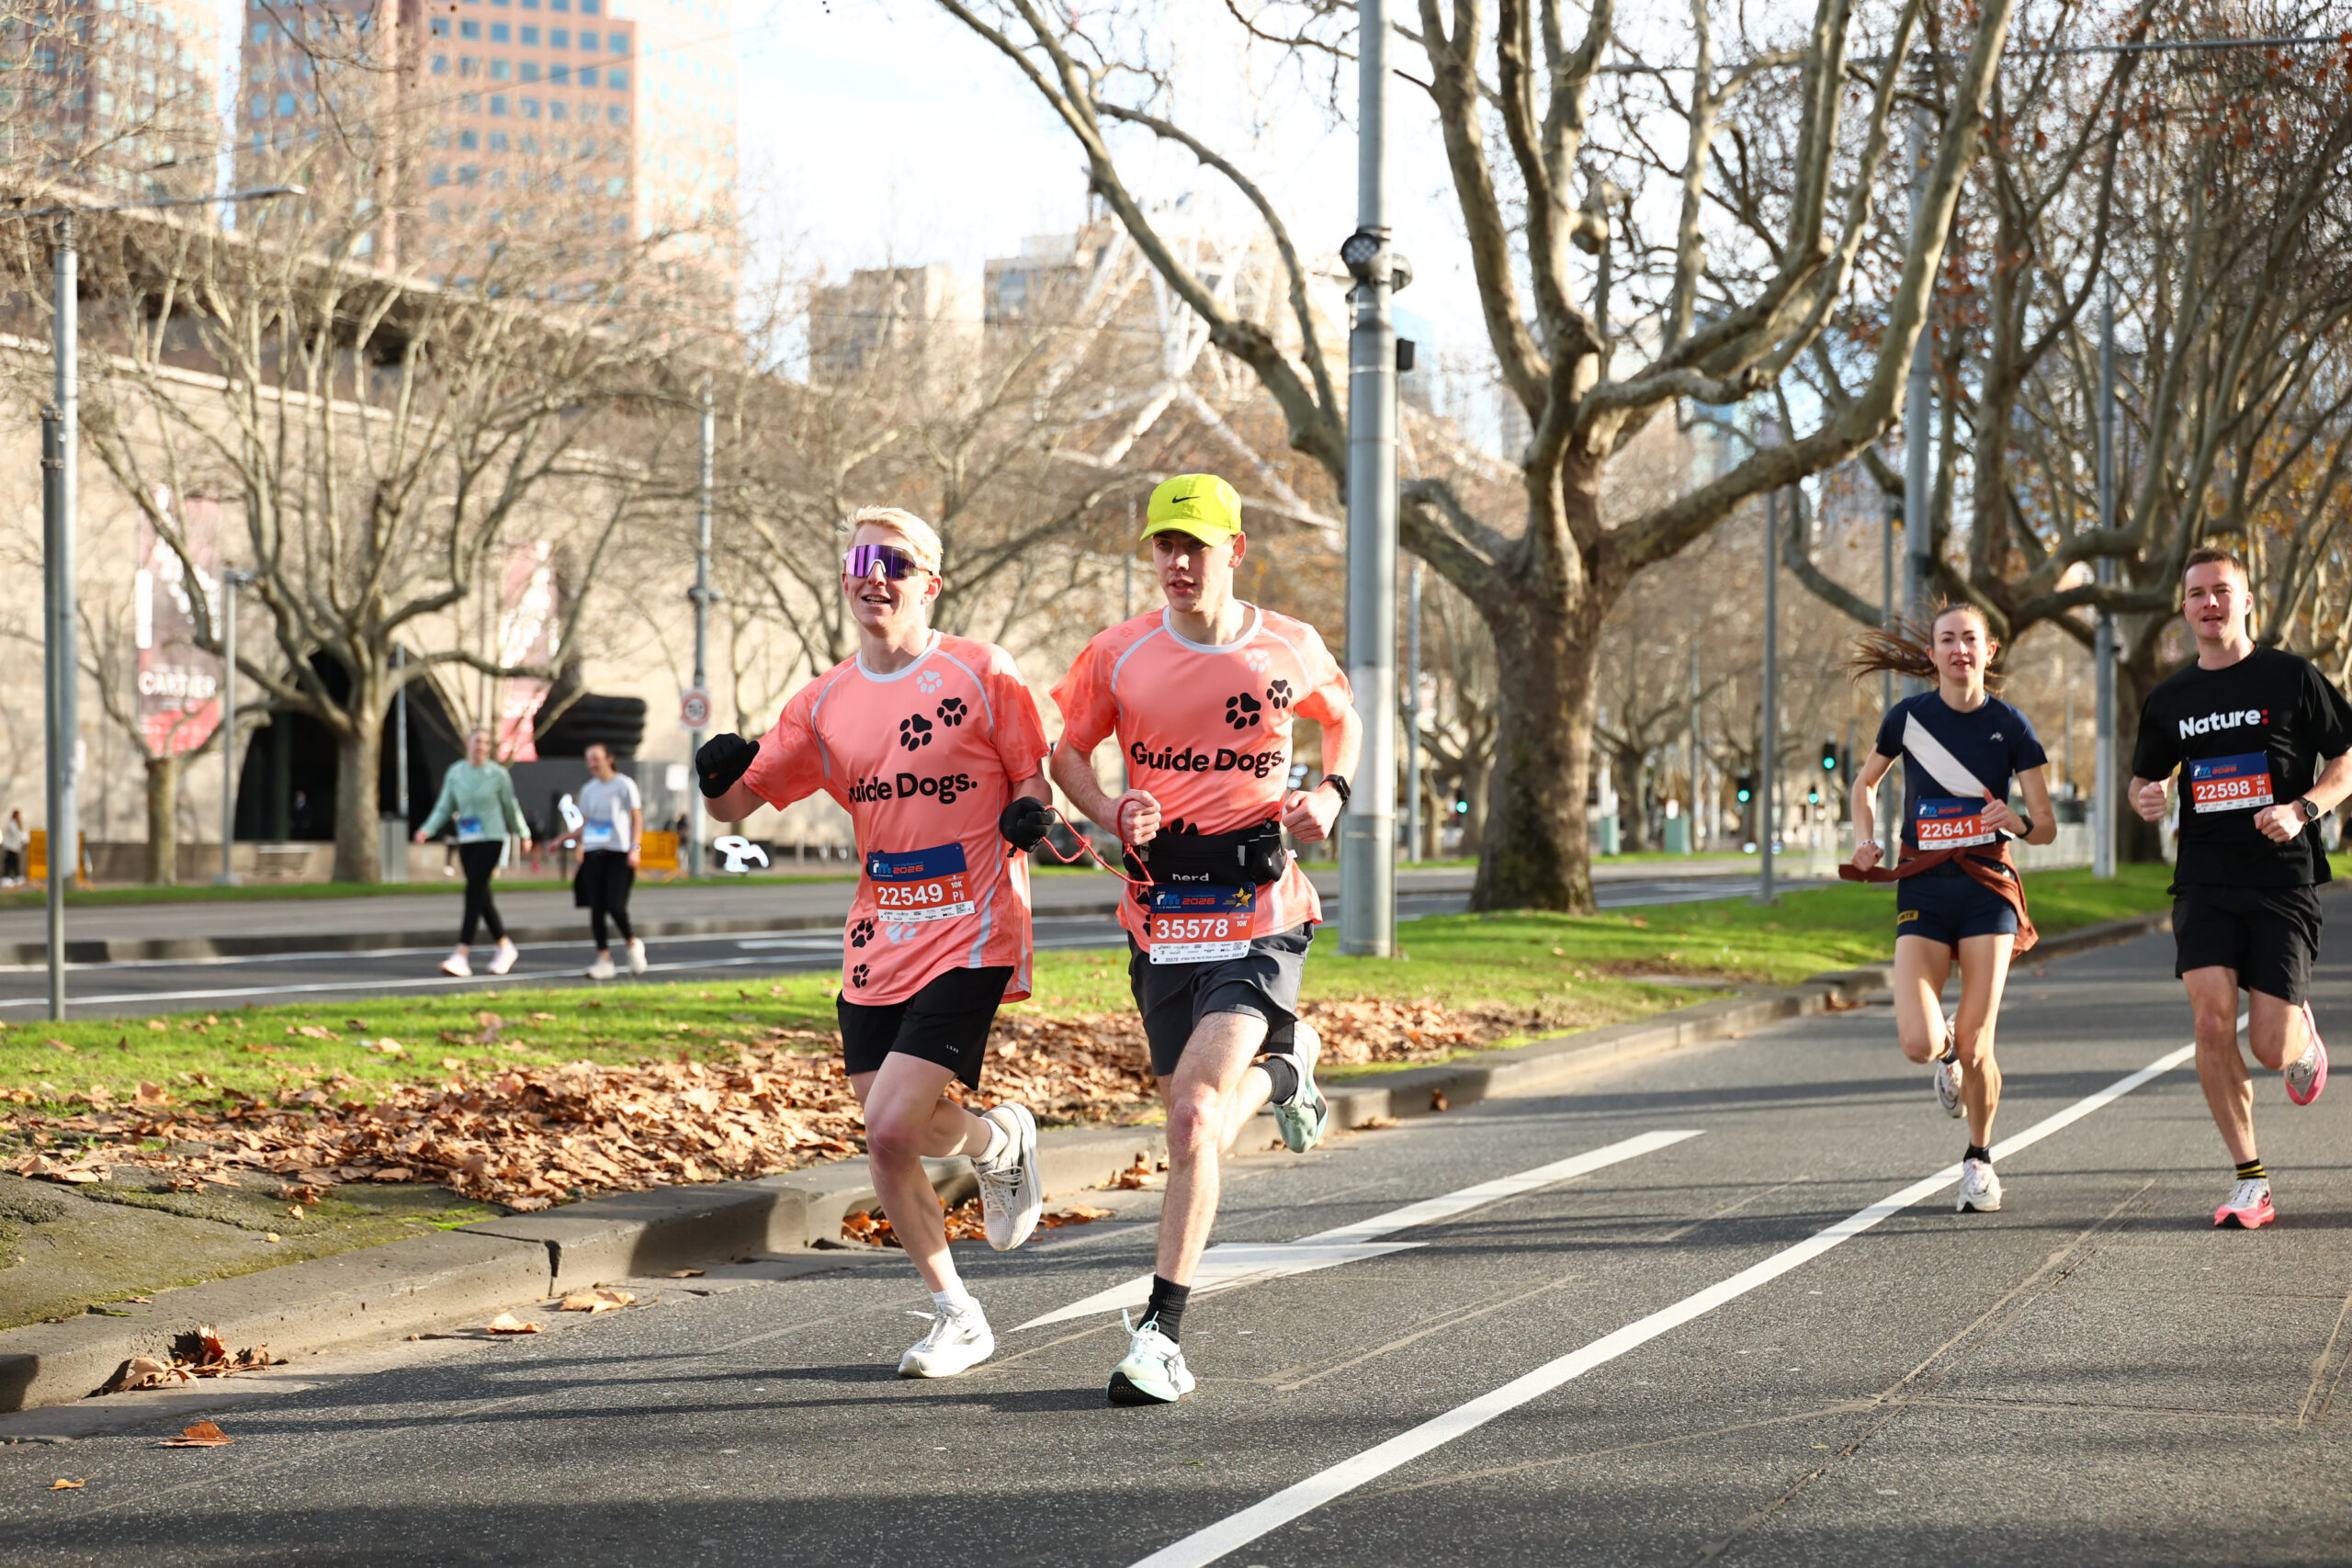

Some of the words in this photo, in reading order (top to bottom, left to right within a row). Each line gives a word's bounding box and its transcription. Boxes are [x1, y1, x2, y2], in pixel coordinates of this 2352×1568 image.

[2178, 708, 2269, 740] Nature:
[1130, 741, 1210, 773] Guide
[848, 776, 892, 804] uide
[896, 772, 978, 805] Dogs.
[2196, 780, 2251, 801] 22598
[1920, 818, 1973, 838] 22641
[892, 864, 924, 874] 2026
[876, 883, 944, 906] 22549
[1182, 897, 1216, 906] 2026
[1156, 919, 1229, 939] 35578
